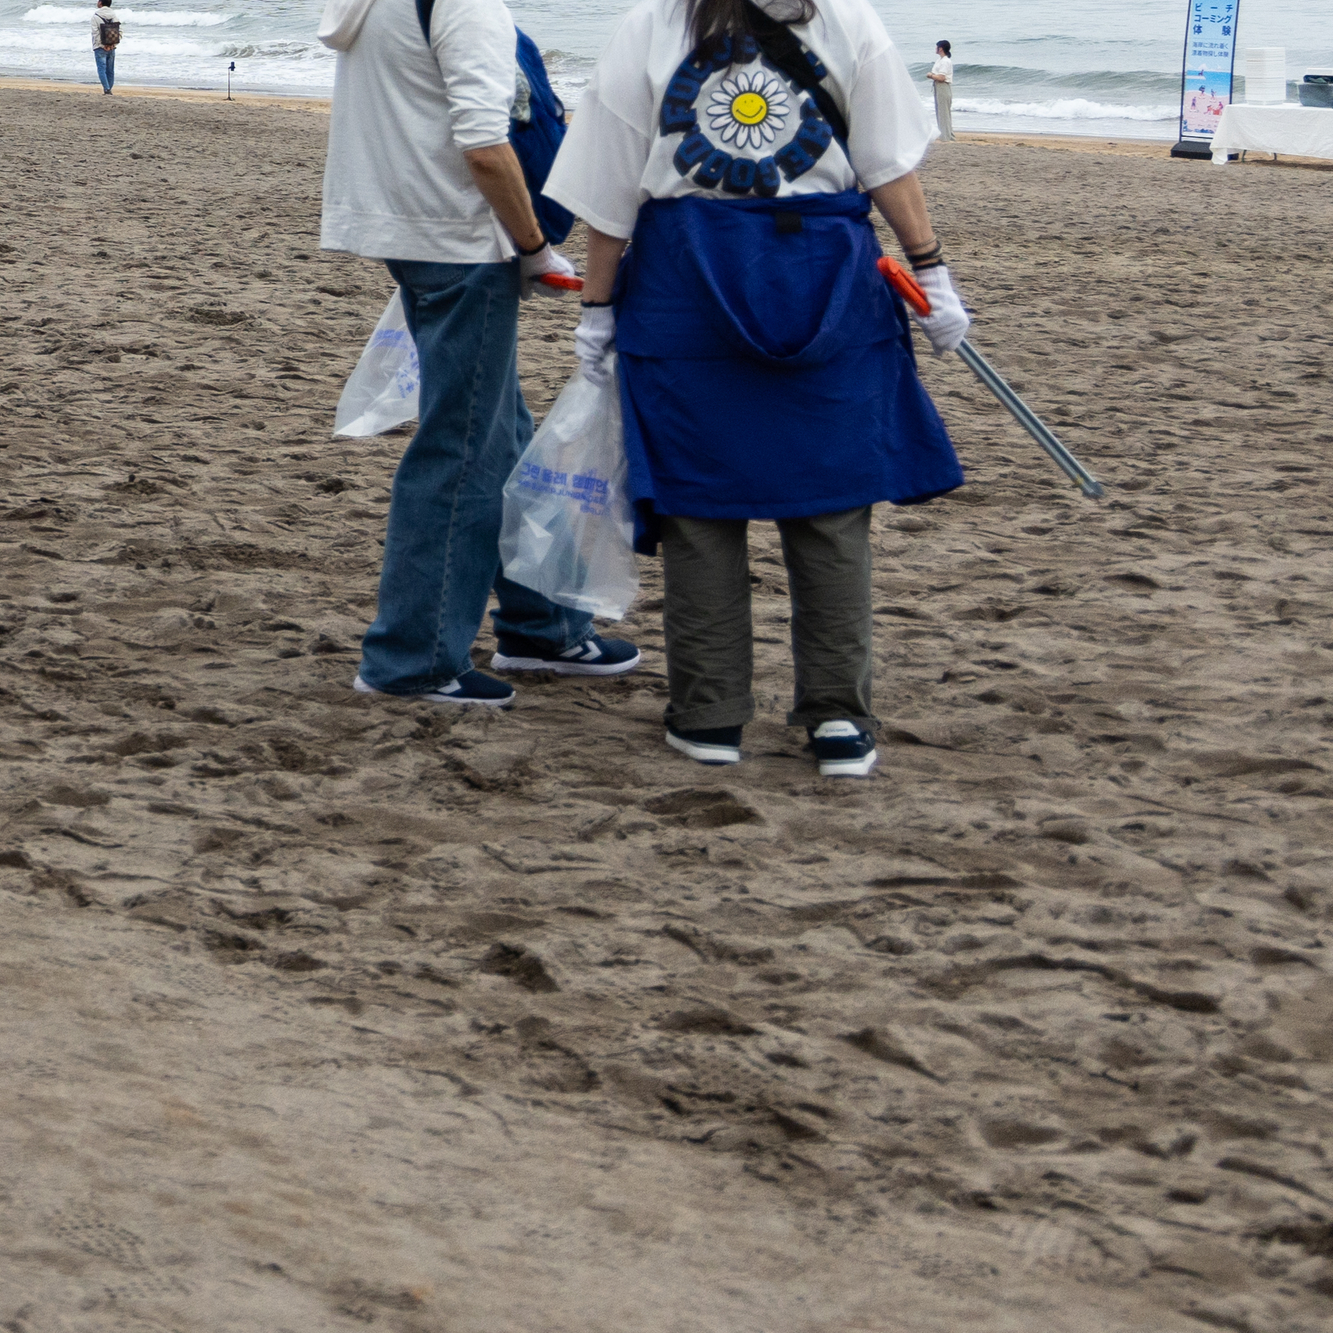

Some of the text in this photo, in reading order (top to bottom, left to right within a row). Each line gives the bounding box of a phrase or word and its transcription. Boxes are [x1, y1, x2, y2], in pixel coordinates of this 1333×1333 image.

[1195, 2, 1233, 13] ビーチ
[1194, 14, 1232, 24] コーミング
[1193, 24, 1232, 36] 体験
[673, 123, 781, 198] GOOD
